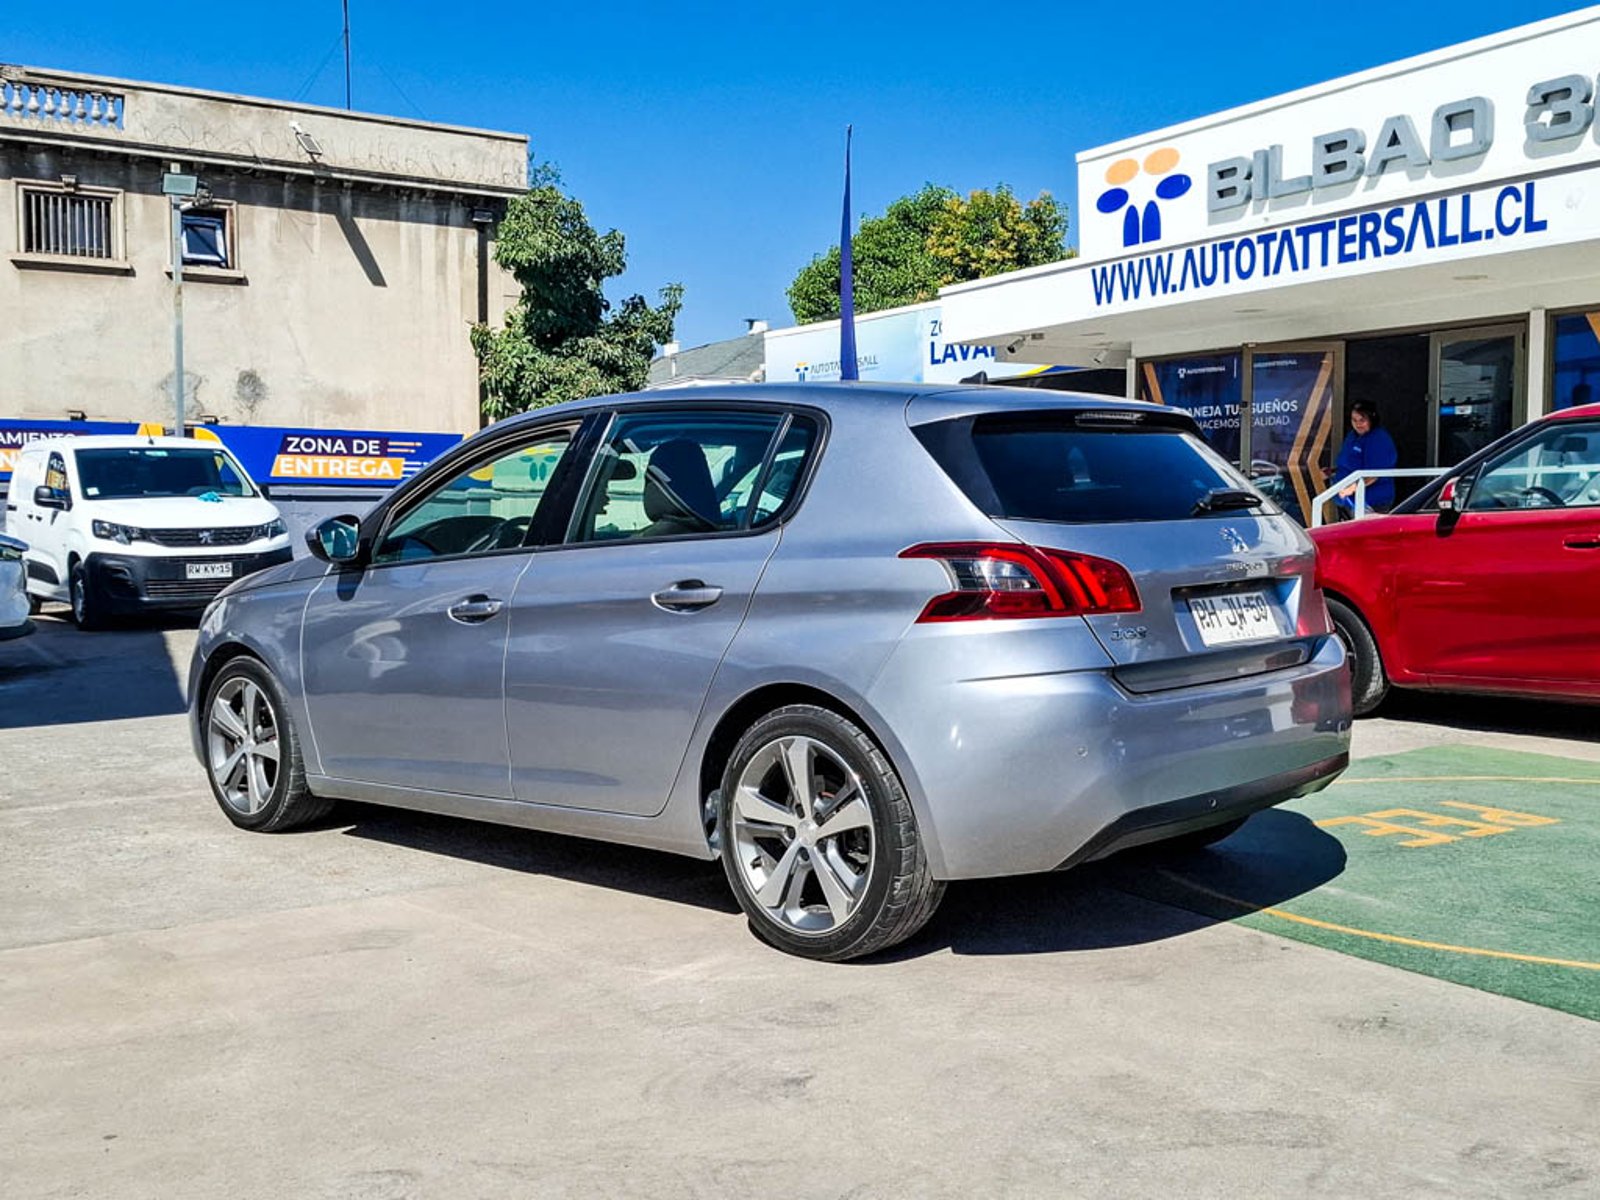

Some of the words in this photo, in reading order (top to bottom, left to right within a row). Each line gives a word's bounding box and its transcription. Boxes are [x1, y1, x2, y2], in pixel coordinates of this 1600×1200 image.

[1207, 95, 1495, 214] BILBAO
[1092, 182, 1548, 306] WWW.AUTOTATTERSALL.CL
[1187, 404, 1222, 418] ANEJA
[1224, 403, 1242, 416] TU
[1252, 415, 1290, 428] ALIDAD
[286, 436, 347, 454] ZONA
[352, 439, 380, 455] DE
[280, 456, 395, 476] ENTREGA
